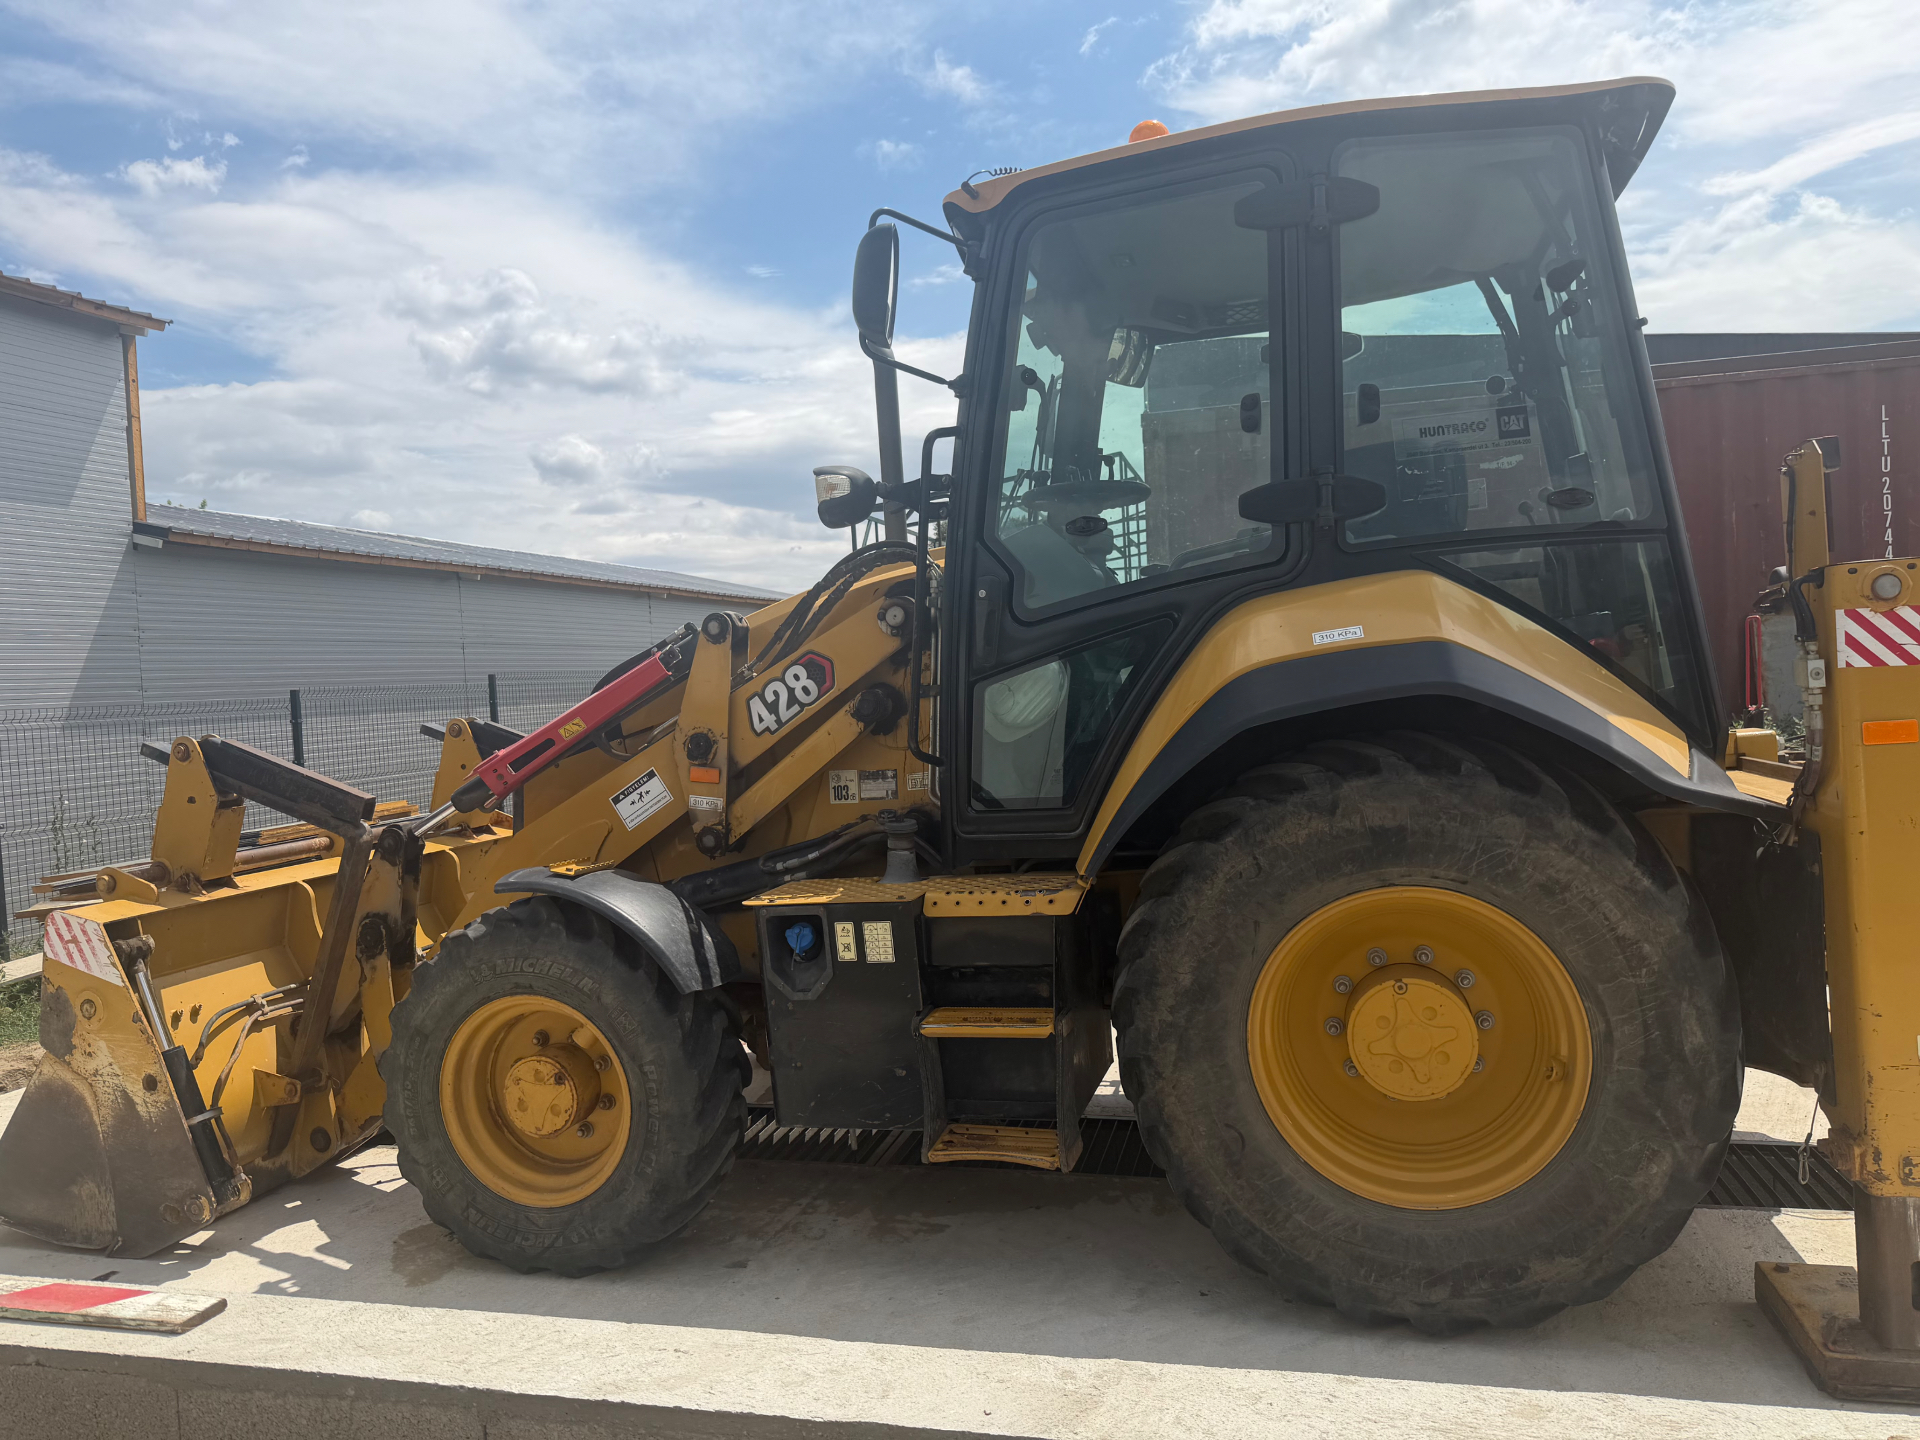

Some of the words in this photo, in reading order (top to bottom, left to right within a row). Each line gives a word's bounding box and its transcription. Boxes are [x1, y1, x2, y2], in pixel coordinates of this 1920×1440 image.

[1418, 420, 1487, 439] HUNTRACO
[1500, 414, 1526, 432] CAT
[1881, 404, 1891, 473] LLTU
[1318, 632, 1335, 641] 310
[1337, 630, 1358, 638] KPa
[749, 664, 819, 734] 428
[624, 775, 650, 796] FIGYELEM!
[831, 784, 850, 801] 103
[692, 798, 704, 807] 310
[705, 800, 719, 808] KPa
[496, 958, 600, 995] MICHELIN
